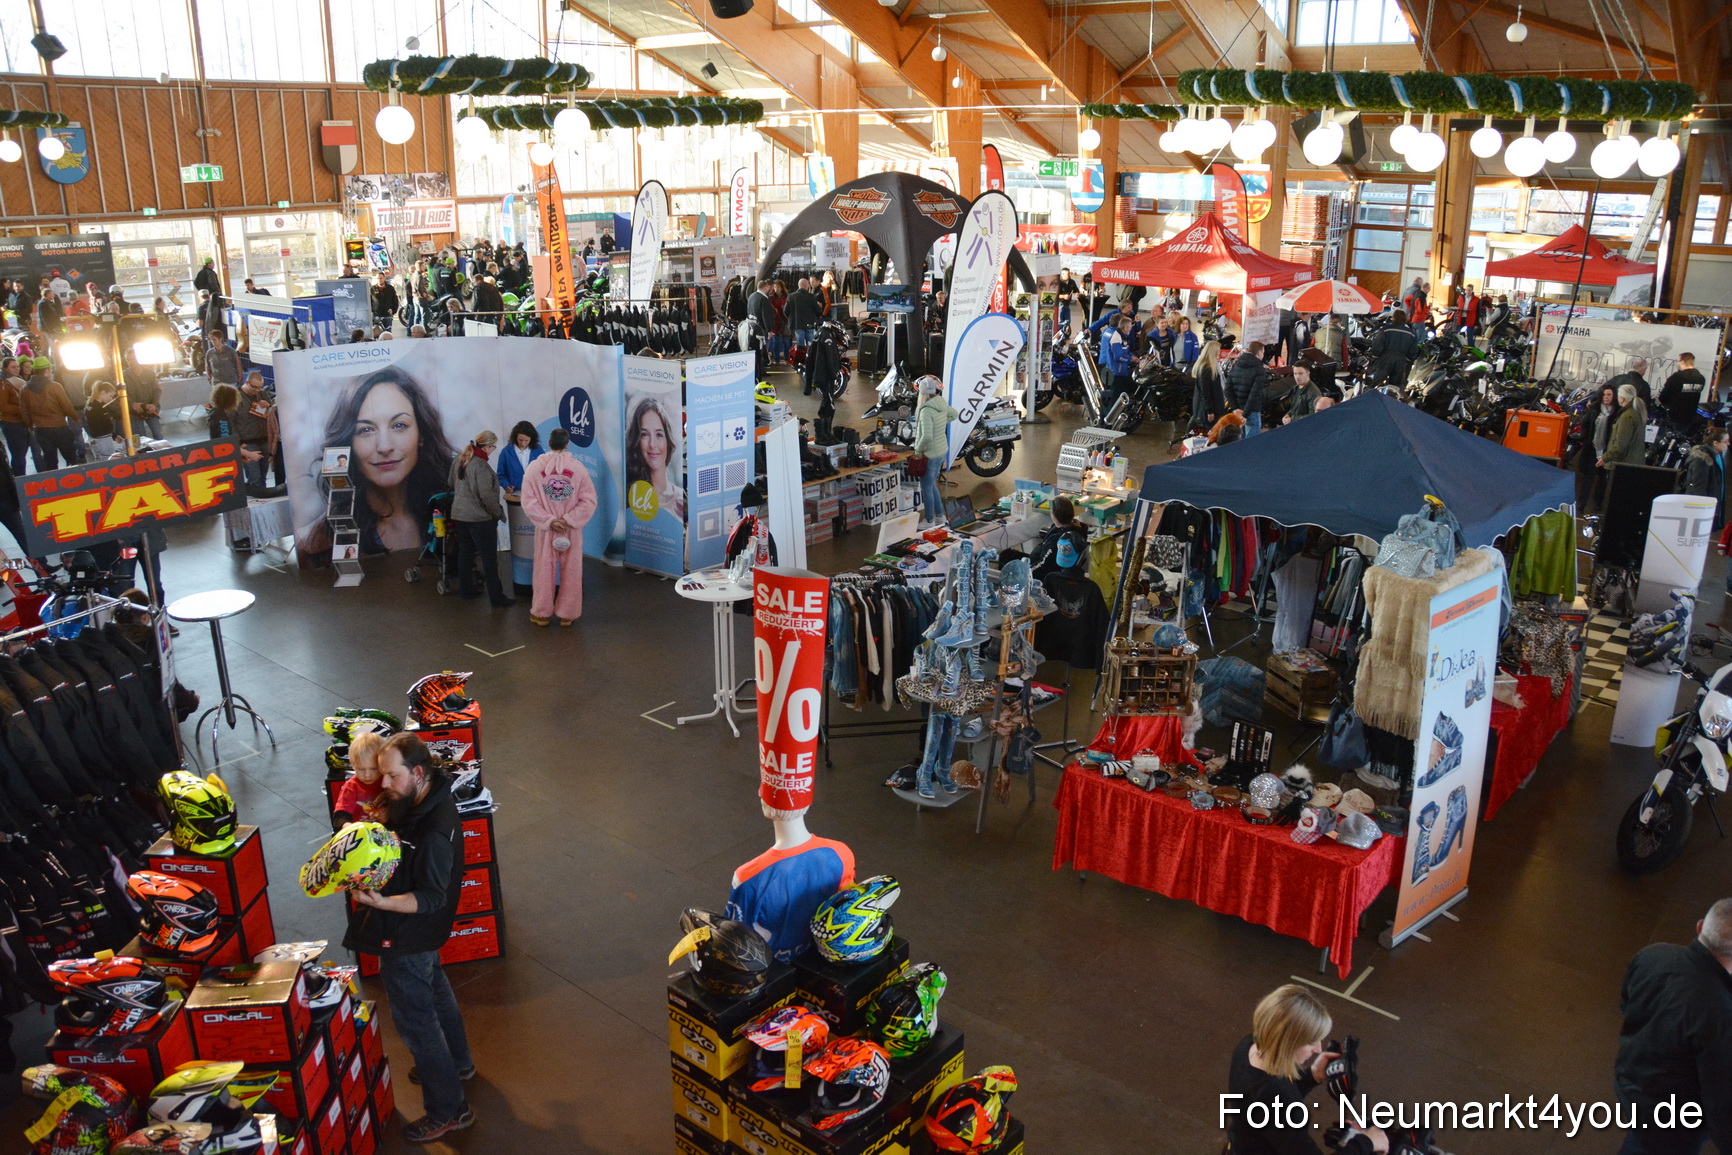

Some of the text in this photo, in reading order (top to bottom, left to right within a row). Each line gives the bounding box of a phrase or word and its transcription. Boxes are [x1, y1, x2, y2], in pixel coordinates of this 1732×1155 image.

[735, 176, 745, 232] KYMCO
[427, 210, 452, 224] RIDE
[41, 247, 102, 256] MOTOR MOMENTS
[49, 241, 72, 249] READY
[72, 240, 87, 248] FOR
[1166, 243, 1214, 254] YAMAHA
[1109, 269, 1140, 281] YAMAHA
[251, 318, 279, 343] Sepp
[1556, 324, 1590, 337] YAMAHA
[312, 347, 391, 364] CARE VISION
[313, 357, 391, 370] AUGENLASERKORREKTUREN
[694, 360, 748, 374] CARE VISION
[627, 367, 675, 380] CARE VISION
[958, 340, 1015, 424] GARMIN
[694, 395, 723, 404] MACHEN
[569, 395, 590, 426] Ich
[24, 443, 236, 497] MOTORRAD
[29, 461, 238, 543] TAF
[632, 483, 653, 511] Ich
[633, 523, 646, 532] OHNE
[756, 583, 823, 613] SALE
[758, 611, 817, 629] REDUZIERT
[754, 636, 822, 744] %
[160, 863, 217, 874] ONEAL
[162, 904, 189, 914] ONEAL
[113, 983, 145, 995] ONEAL
[203, 1011, 273, 1024] ONEAL
[681, 1026, 716, 1053] EXO
[684, 1088, 720, 1116] EXO
[740, 1118, 778, 1148] EXO
